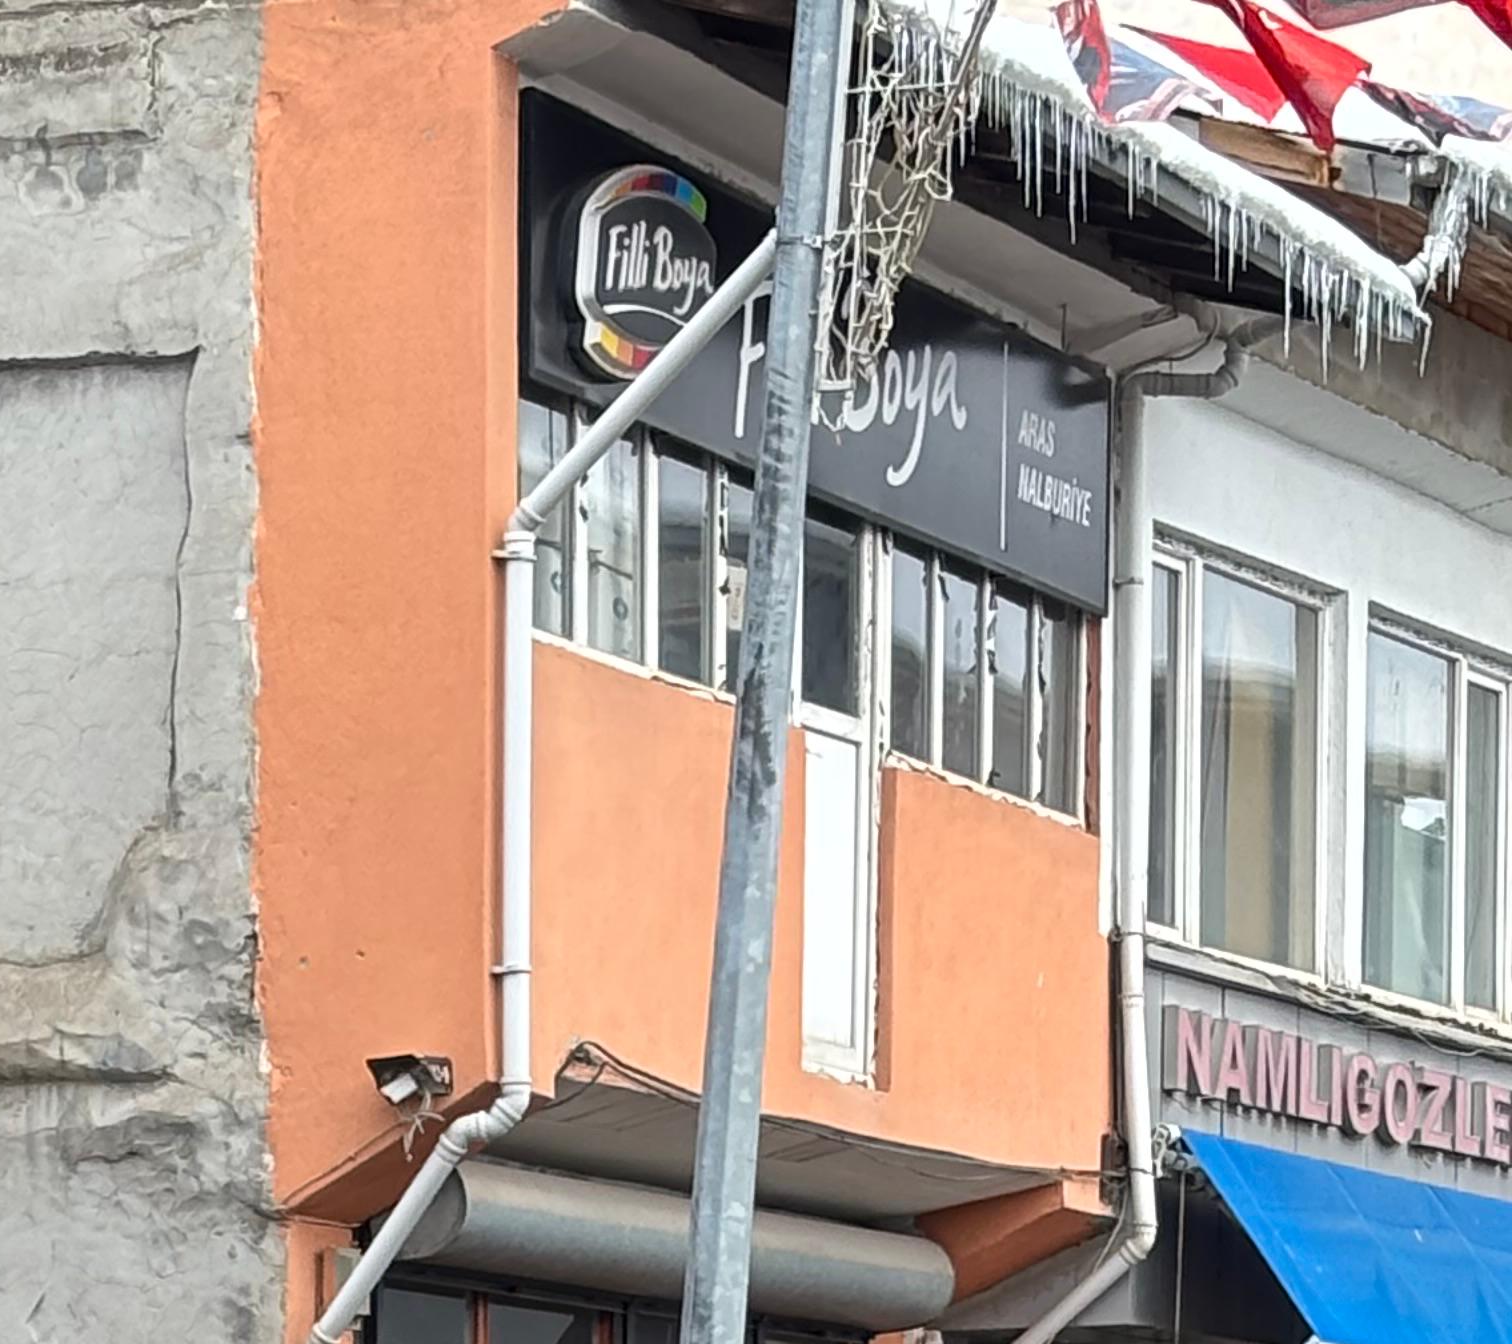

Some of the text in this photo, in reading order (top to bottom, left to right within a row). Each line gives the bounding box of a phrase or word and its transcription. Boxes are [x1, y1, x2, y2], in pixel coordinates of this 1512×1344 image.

[604, 219, 714, 316] Filli Boya
[1017, 409, 1056, 457] ARAS
[1017, 463, 1092, 527] NALBURİYE
